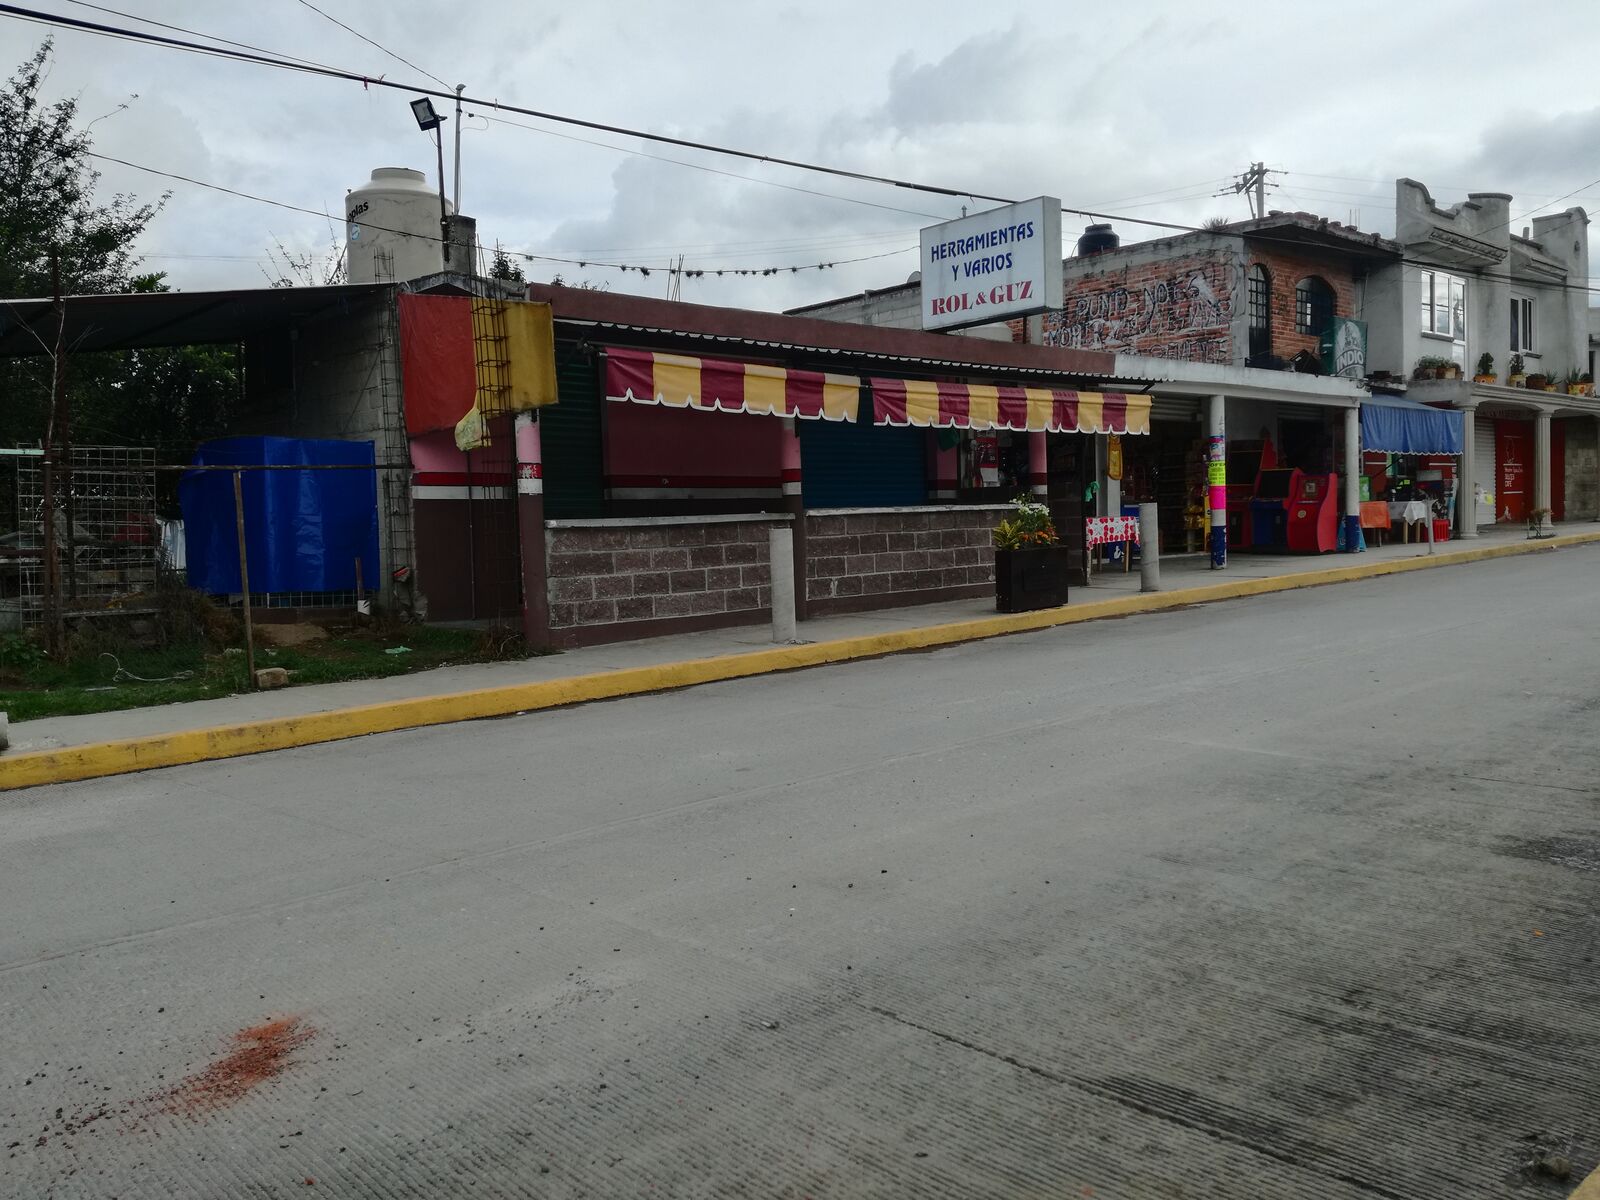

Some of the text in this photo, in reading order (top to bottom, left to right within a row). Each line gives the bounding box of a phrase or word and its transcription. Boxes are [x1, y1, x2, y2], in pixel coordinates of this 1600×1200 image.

[931, 221, 1034, 263] HERRAMIENTAS
[951, 252, 1013, 281] Y VARIOS
[930, 280, 1033, 316] ROL & GUZ
[1336, 349, 1364, 373] INDIO
